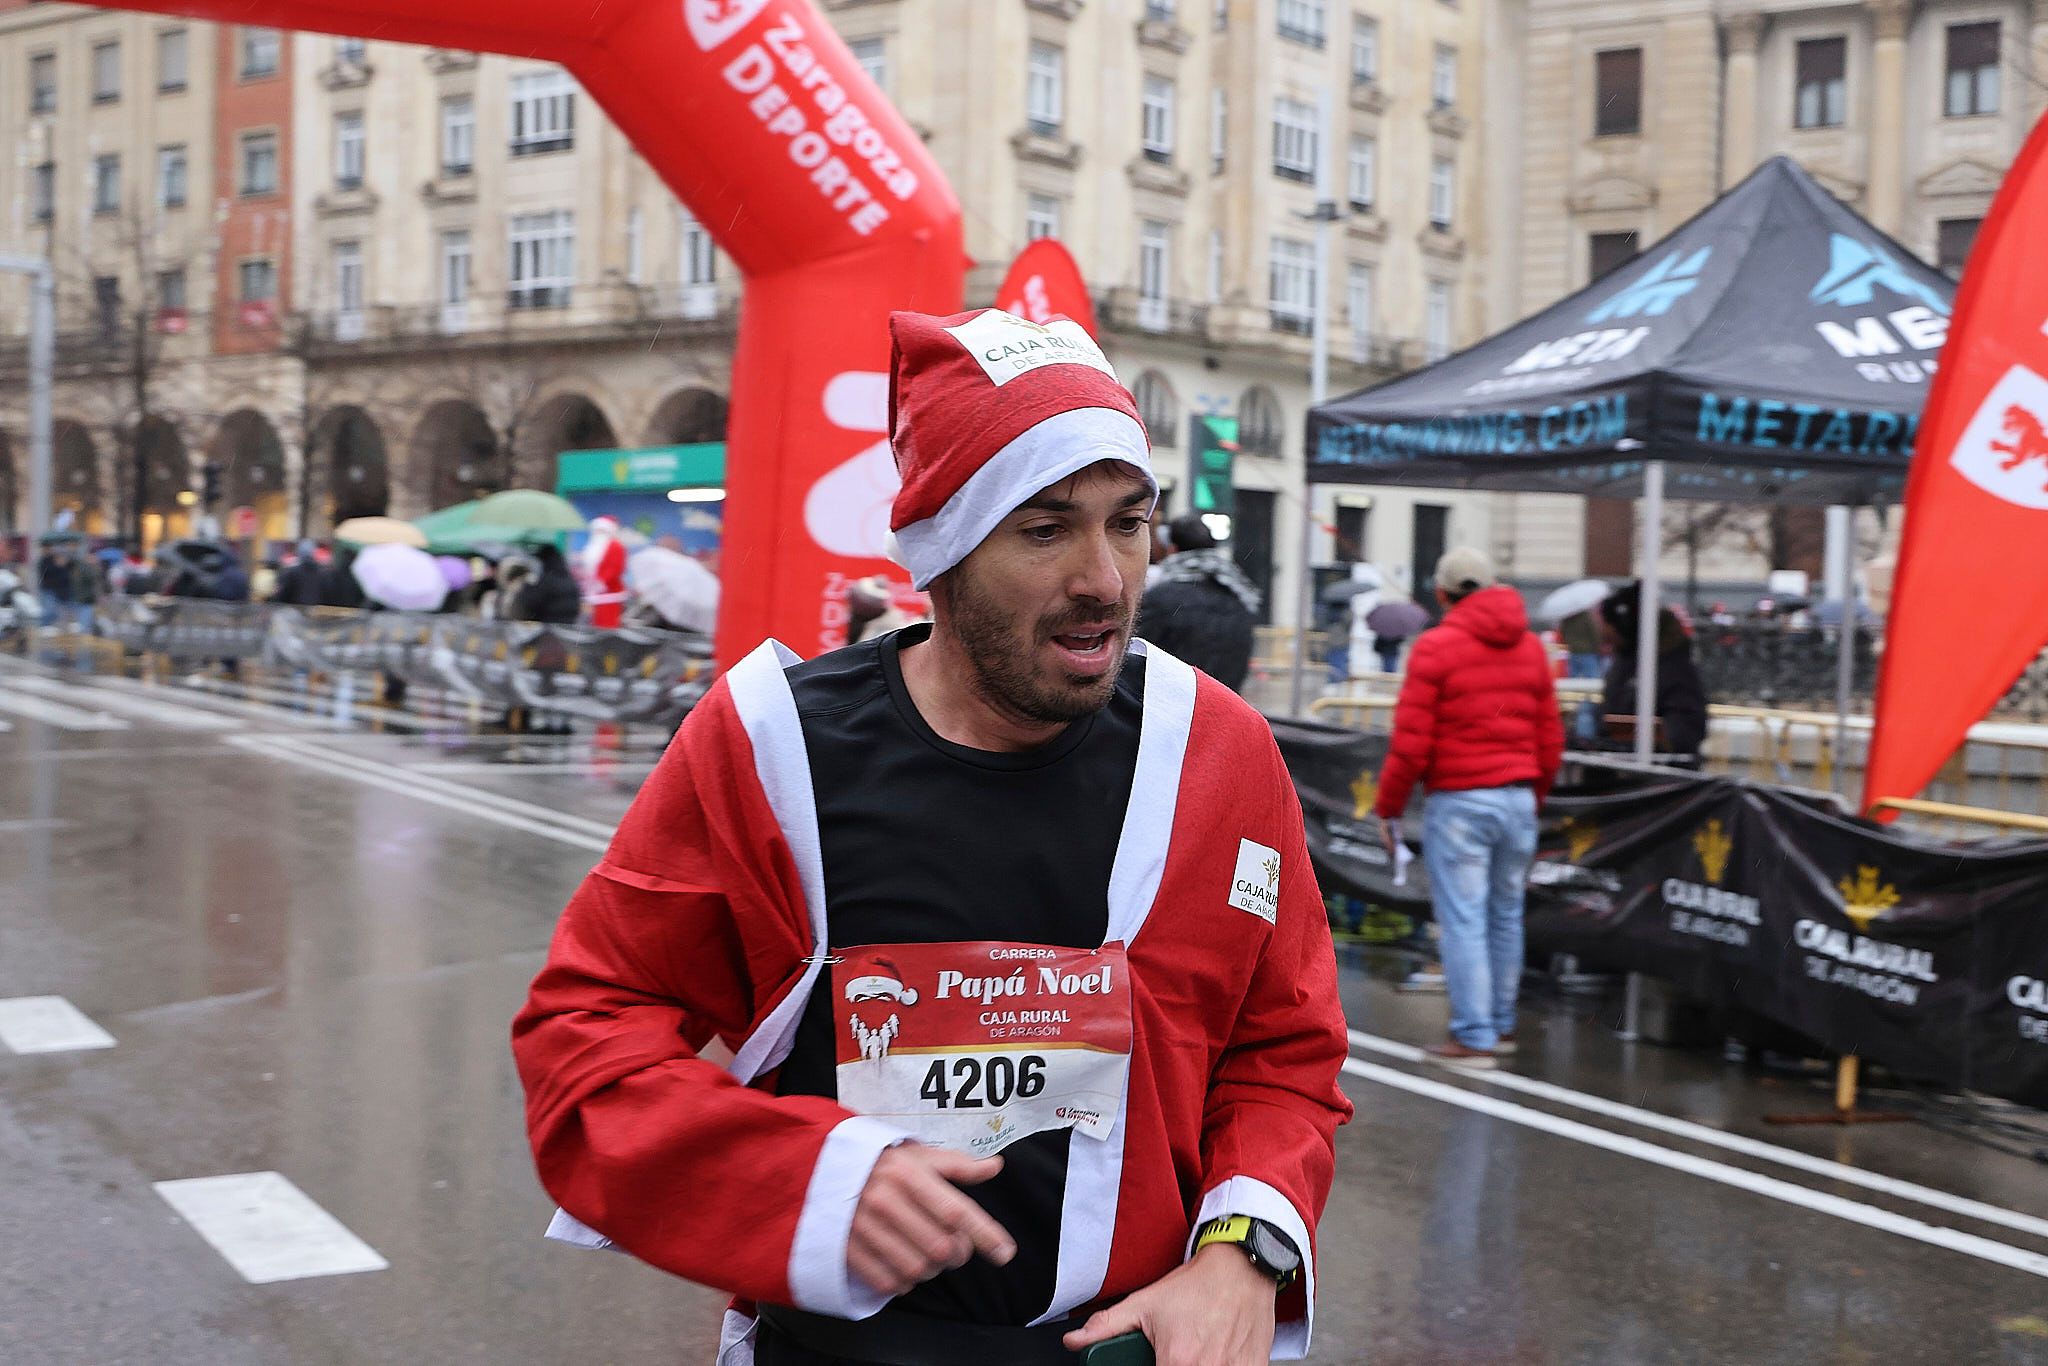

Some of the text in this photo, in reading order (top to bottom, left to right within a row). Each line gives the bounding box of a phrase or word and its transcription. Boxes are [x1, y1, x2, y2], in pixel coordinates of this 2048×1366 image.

[764, 12, 919, 201] Zaragoza
[720, 44, 890, 236] DEPORTE
[985, 339, 1043, 362] CAJA
[1012, 356, 1039, 370] DE
[1236, 880, 1264, 900] CAJA
[1240, 898, 1254, 909] DE
[989, 949, 1057, 960] CARRERA
[935, 965, 1113, 1005] Papá Noel
[2006, 975, 2048, 1015] CA
[979, 1009, 1071, 1025] CAJA RURAL
[990, 1024, 1061, 1038] DE ARAGÓN
[920, 1056, 1047, 1110] 4206
